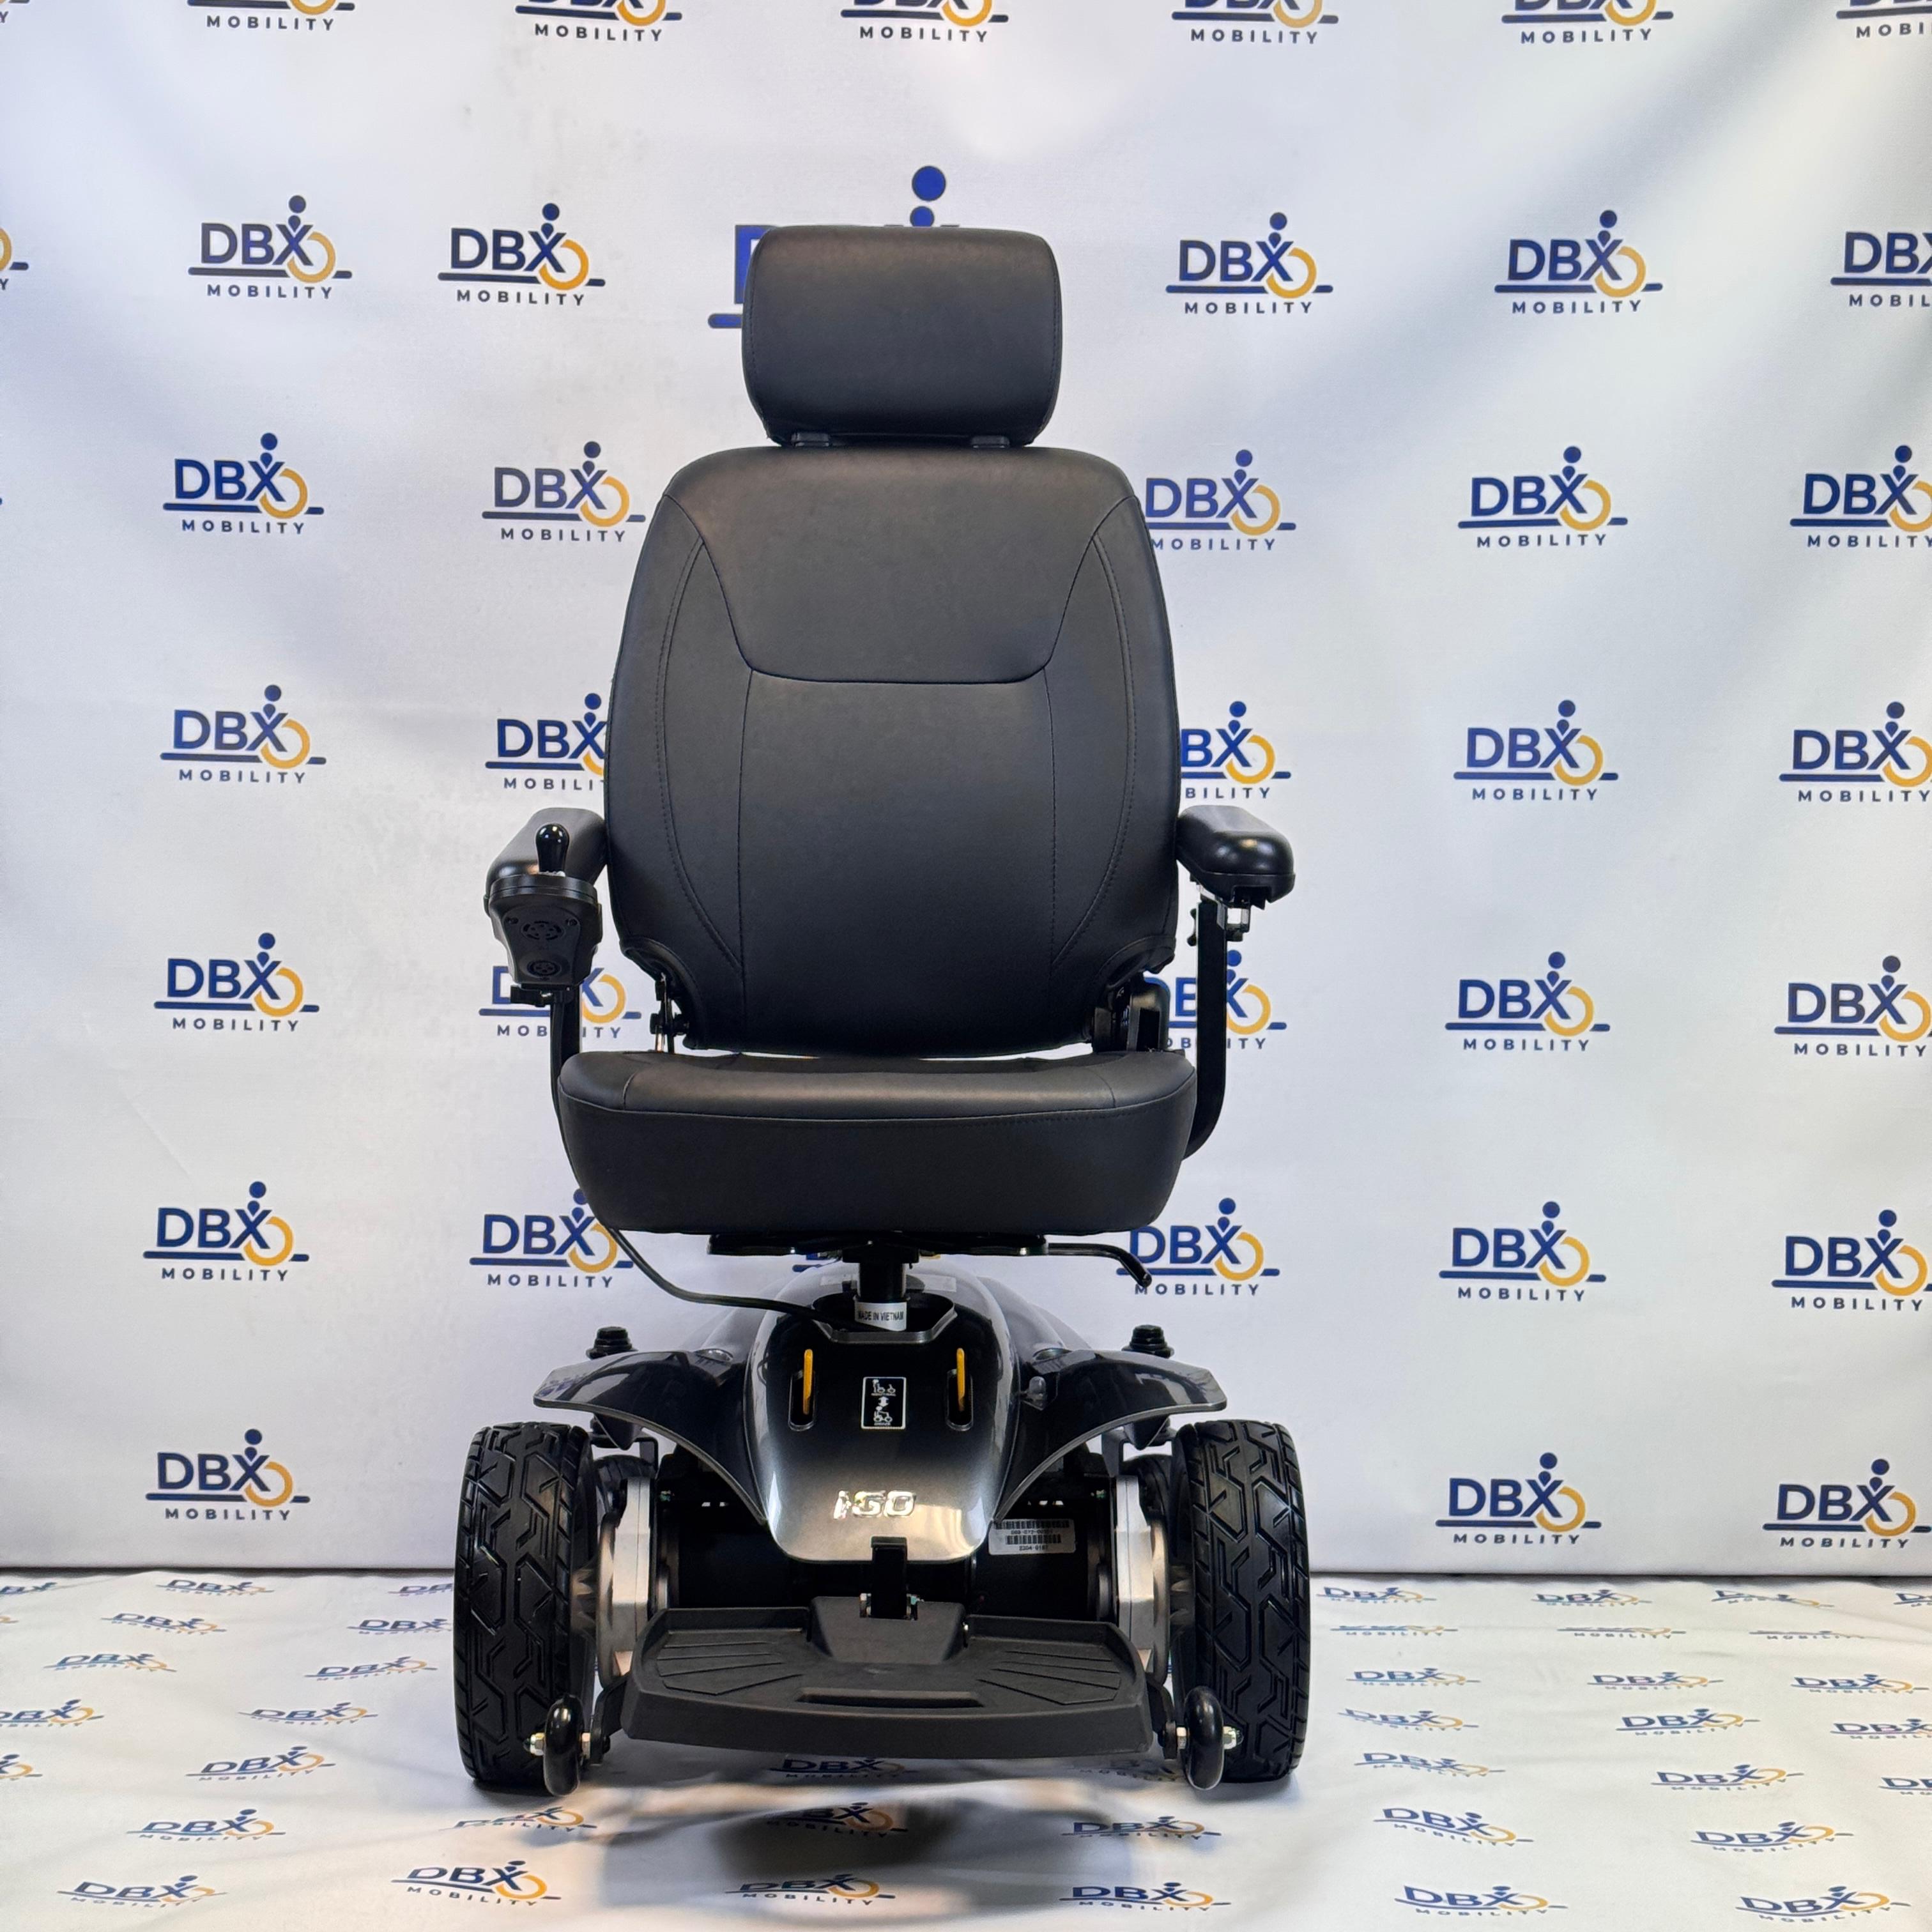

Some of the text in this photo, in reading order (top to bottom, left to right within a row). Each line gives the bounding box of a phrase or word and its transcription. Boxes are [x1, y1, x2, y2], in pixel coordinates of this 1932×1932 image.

[206, 15, 334, 31] MOBILITY
[1856, 22, 1932, 38] MOBI
[535, 23, 662, 42] MOBILITY
[860, 26, 987, 42] MOBILITY
[1191, 29, 1317, 44] MOBILITY
[1521, 28, 1651, 44] MOBILITY
[201, 222, 314, 266] DBX
[450, 227, 567, 273] DBX
[1179, 240, 1294, 282] DBX
[1507, 238, 1623, 281] DBX
[207, 284, 332, 299] MOBILITY
[457, 289, 584, 306] MOBILITY
[1184, 302, 1312, 314] MOBILITY
[1512, 300, 1641, 314] MOBILITY
[1849, 294, 1931, 307] MOBIL
[174, 458, 286, 502] DBX
[494, 467, 608, 510] DBX
[1471, 473, 1588, 517] DBX
[1803, 473, 1919, 516] DBX
[1145, 477, 1260, 519] DBX
[182, 519, 304, 534] MOBILITY
[501, 528, 625, 542] MOBILITY
[1477, 534, 1606, 548] MOBILITY
[1152, 538, 1275, 551] MOBILITY
[173, 709, 288, 753] DBX
[497, 719, 608, 760] DBX
[1181, 728, 1253, 767] BX
[1466, 727, 1581, 769] DBX
[1793, 729, 1912, 770] DBX
[179, 769, 305, 783] MOBILITY
[503, 778, 604, 791] MOBILI
[1185, 787, 1270, 799] BILITY
[1472, 788, 1597, 801] MOBILITY
[1798, 790, 1930, 802] MOBILITY
[167, 958, 282, 1000] DBX
[1458, 979, 1572, 1020] DBX
[1788, 983, 1908, 1025] DBX
[172, 1018, 298, 1032] MOBILITY
[497, 1024, 621, 1039] MOBITY
[1463, 1038, 1589, 1051] MOBILITY
[1794, 1043, 1926, 1057] MOBILITY
[157, 1207, 272, 1250] DBX
[482, 1214, 595, 1256] DBX
[1129, 1225, 1243, 1264] DBX
[1452, 1227, 1567, 1269] DBX
[1785, 1236, 1904, 1279] DBX
[162, 1268, 288, 1282] MOBILITY
[487, 1274, 612, 1287] MOBILITY
[1458, 1287, 1584, 1302] MOBILITY
[1791, 1296, 1922, 1311] MOBILITY
[880, 1310, 904, 1321] VIETNAM
[157, 1452, 271, 1492] DBX
[1448, 1478, 1563, 1519] DBX
[1777, 1483, 1895, 1522] DBX
[165, 1508, 290, 1521] MOBILITY
[1453, 1533, 1579, 1545] MOBILITY
[1780, 1537, 1908, 1549] MOBILITY
[1793, 1676, 1895, 1688] DBX
[1621, 1712, 1724, 1728] DBX
[201, 1752, 308, 1774] DBX
[781, 1758, 884, 1771] DBX
[1656, 1768, 1765, 1784] DBX
[141, 1818, 257, 1833] DBX
[1382, 1807, 1495, 1837] DBX
[1696, 1825, 1812, 1844] DBX
[406, 1866, 528, 1891] DBX
[73, 1881, 200, 1899] DBX
[407, 1885, 537, 1906] MOBILITY
[1072, 1885, 1190, 1902] DBX
[1404, 1885, 1524, 1907] DBX
[742, 1892, 873, 1906] MOBILITY
[1740, 1891, 1866, 1913] DBX
